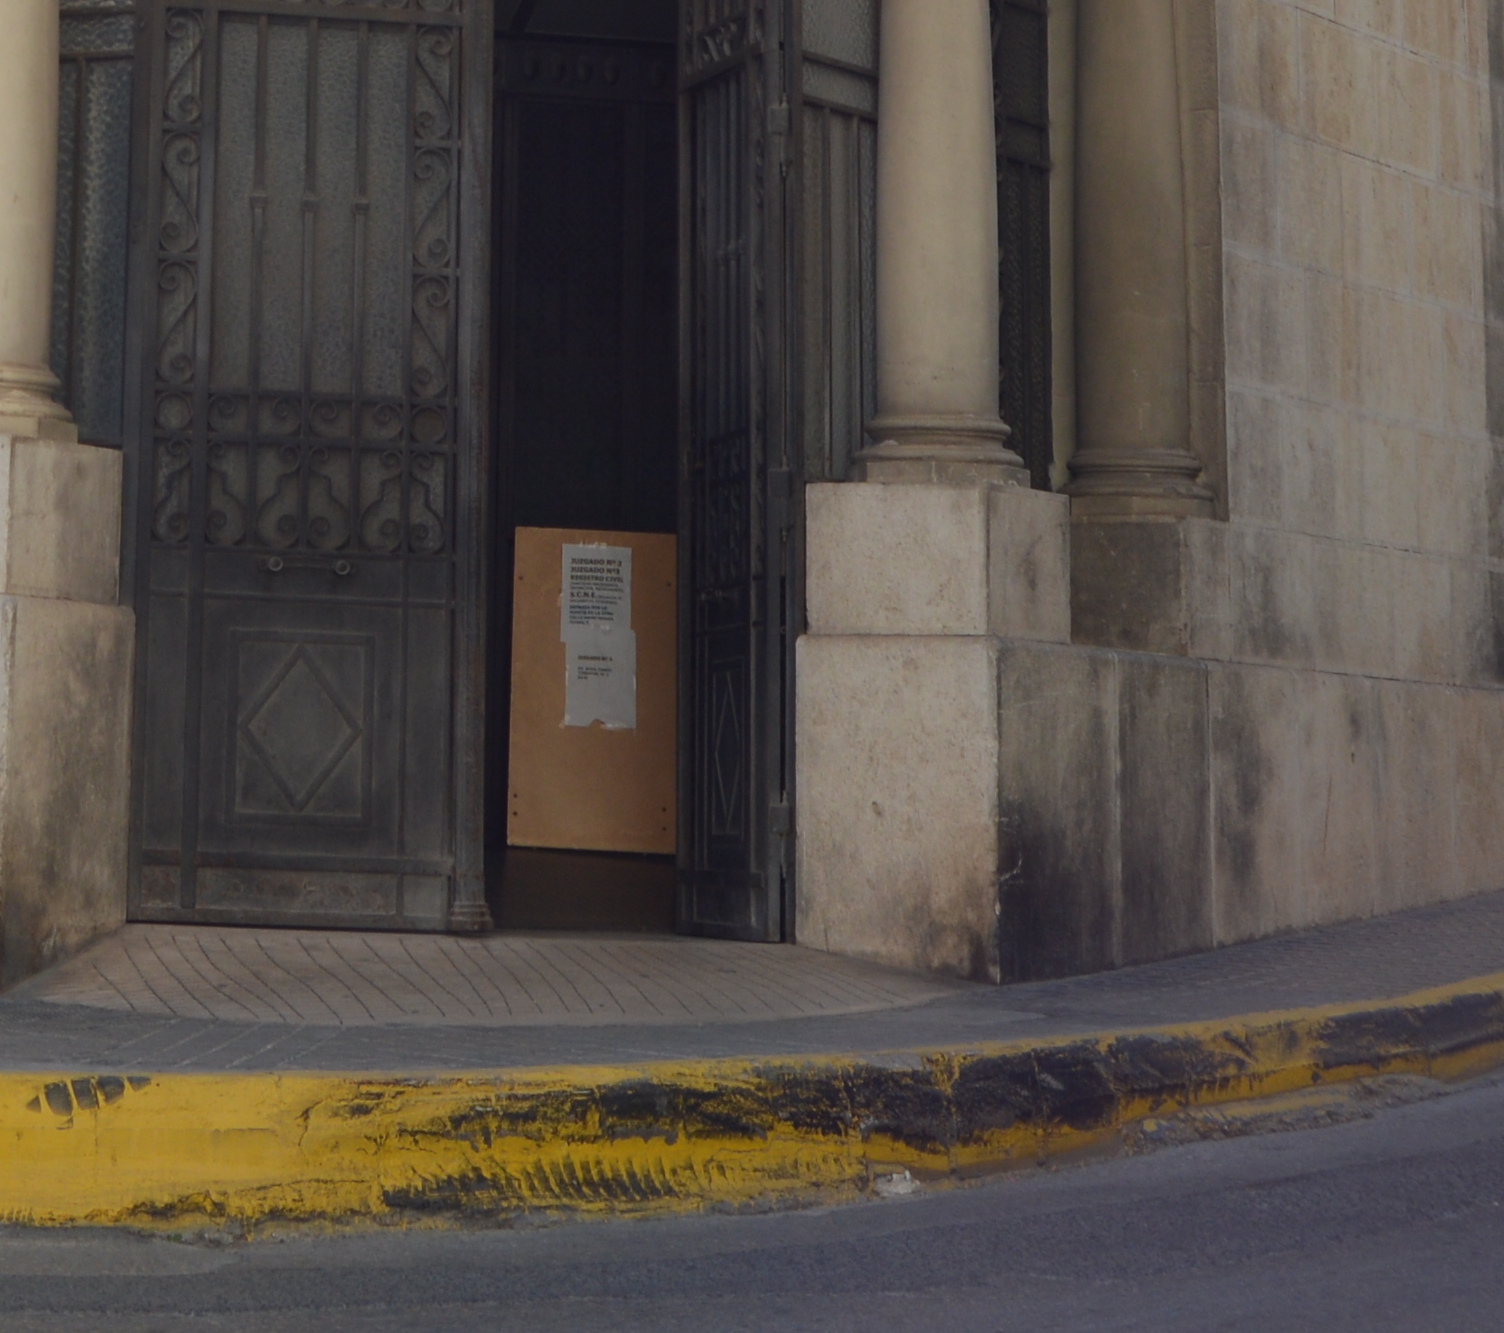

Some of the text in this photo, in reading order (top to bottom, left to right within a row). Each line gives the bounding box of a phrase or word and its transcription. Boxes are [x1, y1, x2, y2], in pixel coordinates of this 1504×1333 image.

[571, 557, 605, 565] JUZGADO
[571, 566, 605, 574] JUZGADO
[570, 574, 604, 582] REGISTRO
